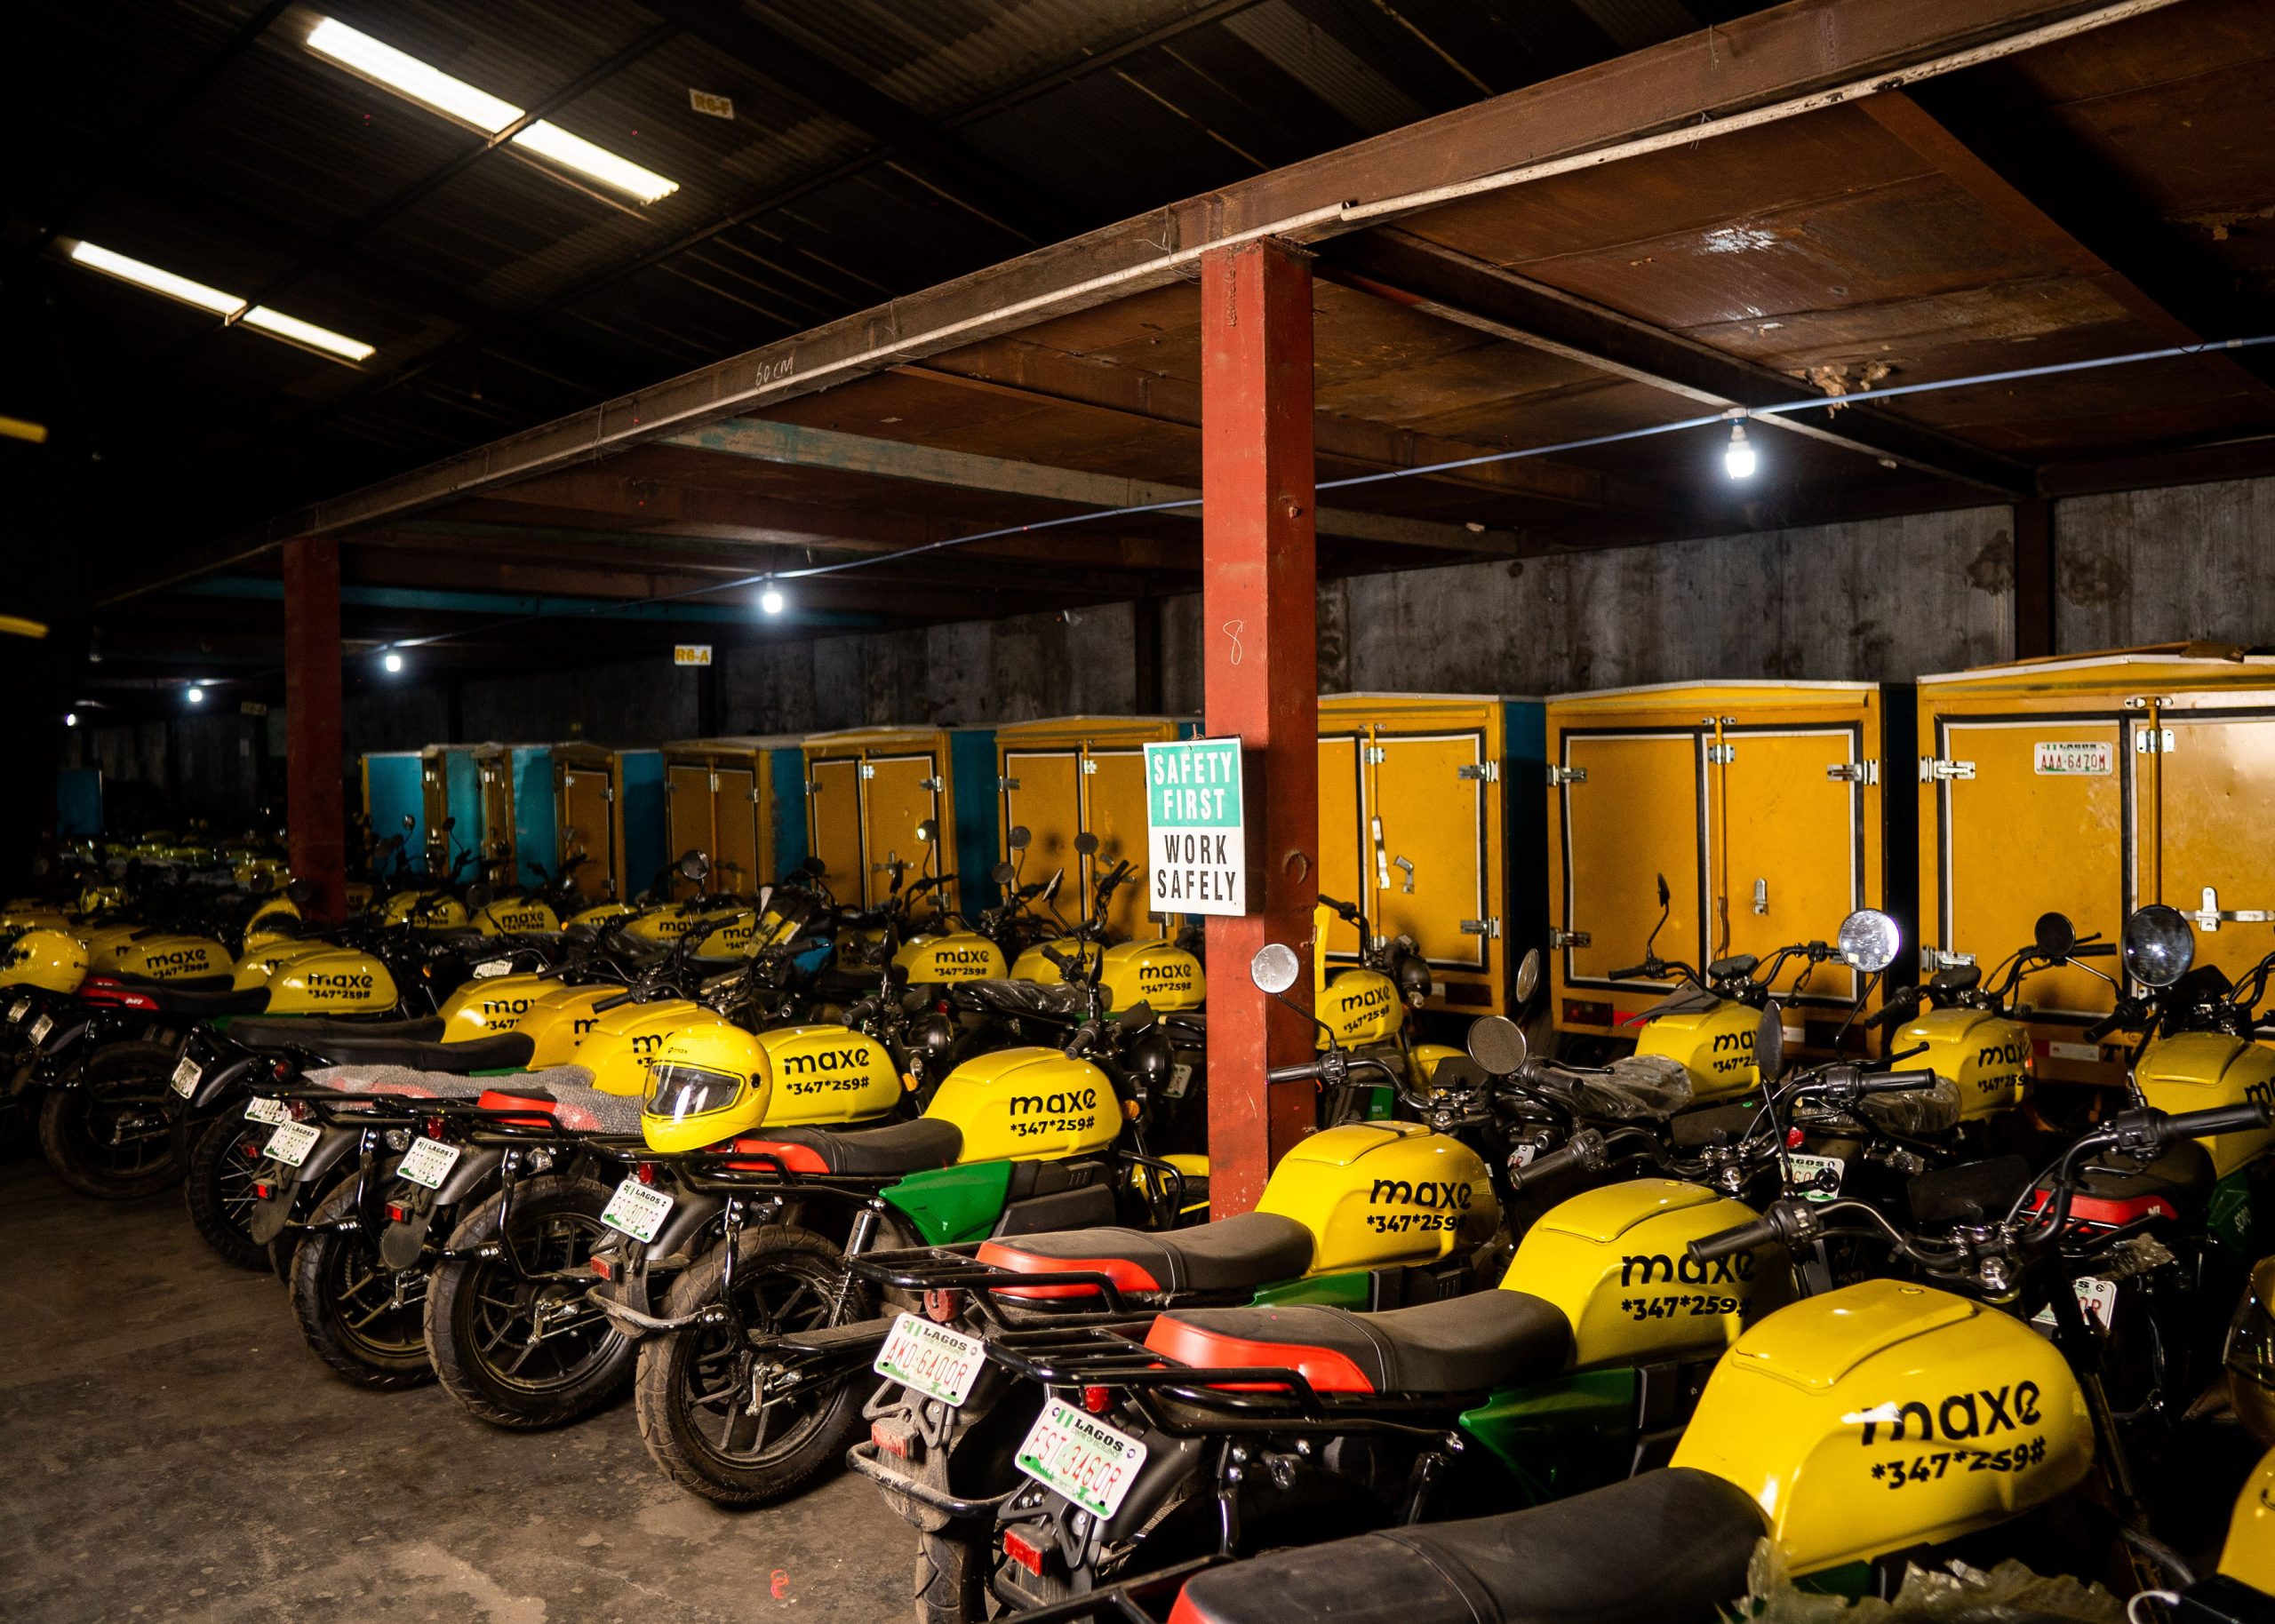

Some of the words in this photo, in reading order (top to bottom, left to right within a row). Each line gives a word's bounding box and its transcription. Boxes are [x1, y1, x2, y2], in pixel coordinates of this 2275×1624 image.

[1153, 752, 1233, 784] SAFETY
[1162, 788, 1225, 820] FIRST
[1164, 834, 1227, 865] WORK
[1157, 870, 1236, 902] SAFELY
[501, 911, 545, 924] maxe
[659, 920, 691, 933] ma
[722, 926, 753, 940] ma
[146, 947, 206, 969] maxe
[935, 948, 989, 964] maxe
[307, 972, 373, 989] maxe
[1138, 963, 1192, 980] maxe
[483, 996, 534, 1015] ma
[1341, 985, 1390, 1013] maxe
[1712, 1030, 1757, 1053] ma
[783, 1047, 870, 1076] maxe
[1010, 1087, 1098, 1117] maxe
[635, 1189, 661, 1205] LAGOS
[1369, 1179, 1473, 1211] maxe
[1621, 1248, 1755, 1288] maxe
[923, 1327, 969, 1352] LAGOS
[1862, 1380, 2041, 1446] maxe
[1074, 1419, 1125, 1453] LAGOS
